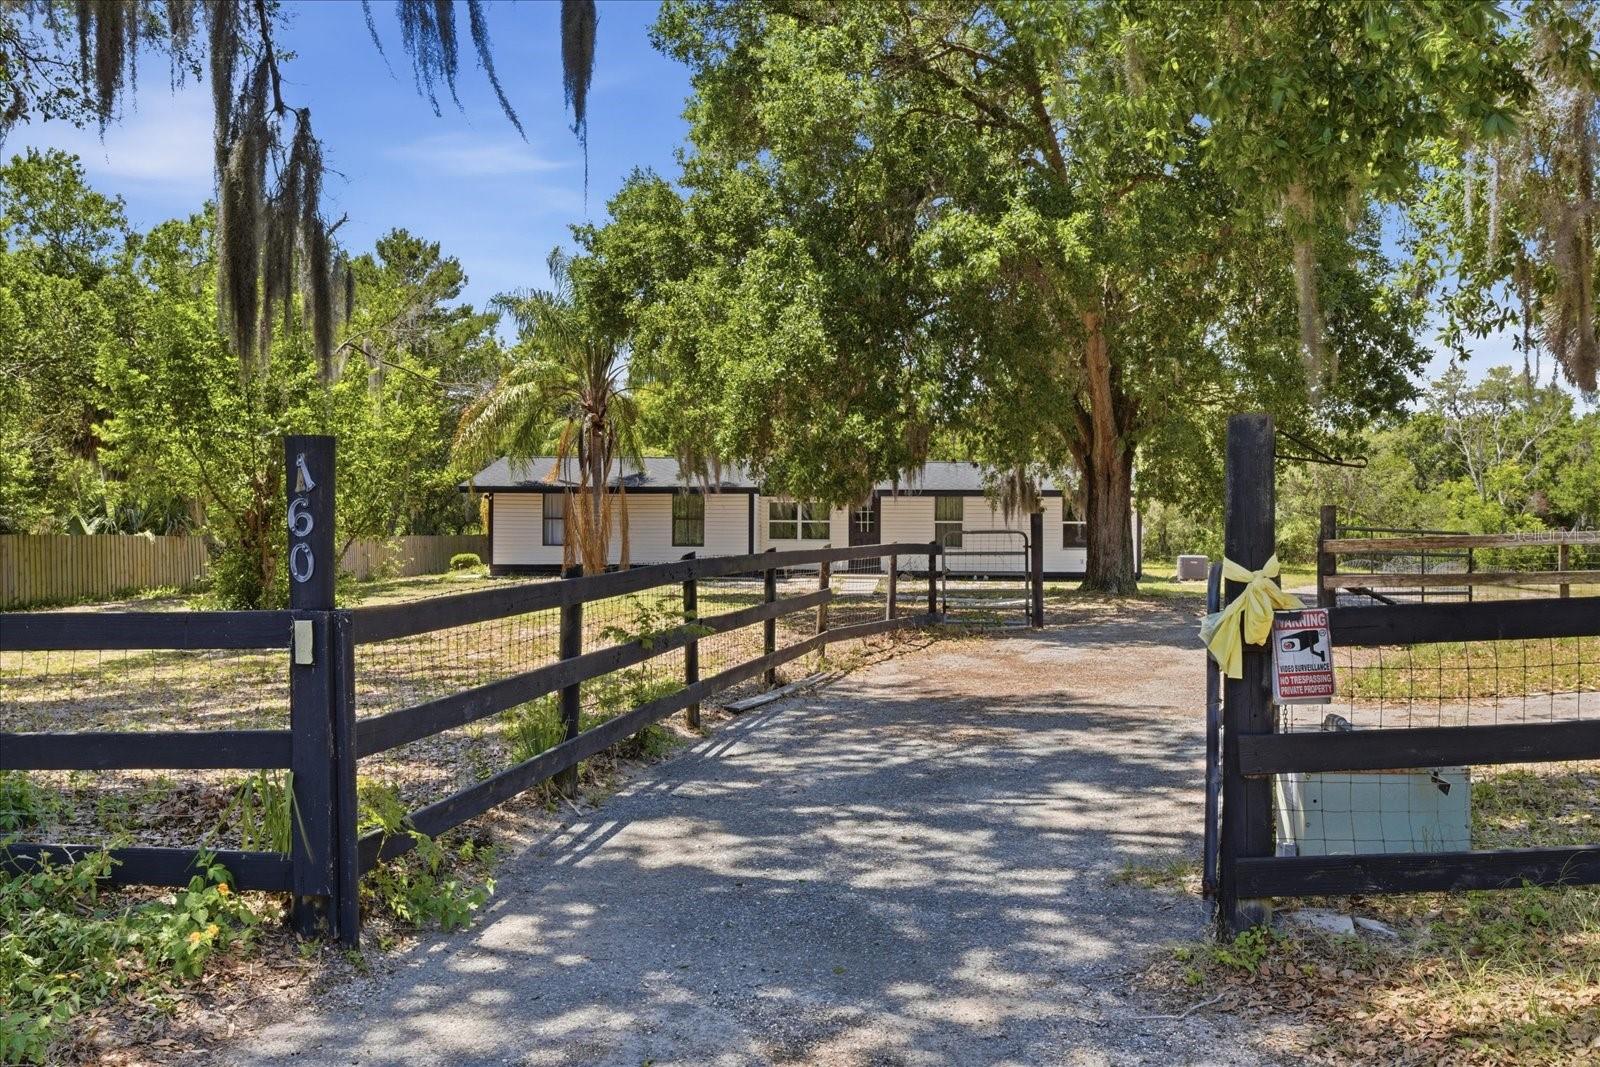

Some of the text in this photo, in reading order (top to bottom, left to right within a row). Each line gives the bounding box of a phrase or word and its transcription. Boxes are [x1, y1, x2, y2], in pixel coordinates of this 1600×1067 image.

[1280, 662, 1330, 673] VIDEO SURVEILLANCE
[1280, 674, 1331, 685] NO TRESPASSING
[1280, 684, 1332, 695] PRIVATE PROPERTY
